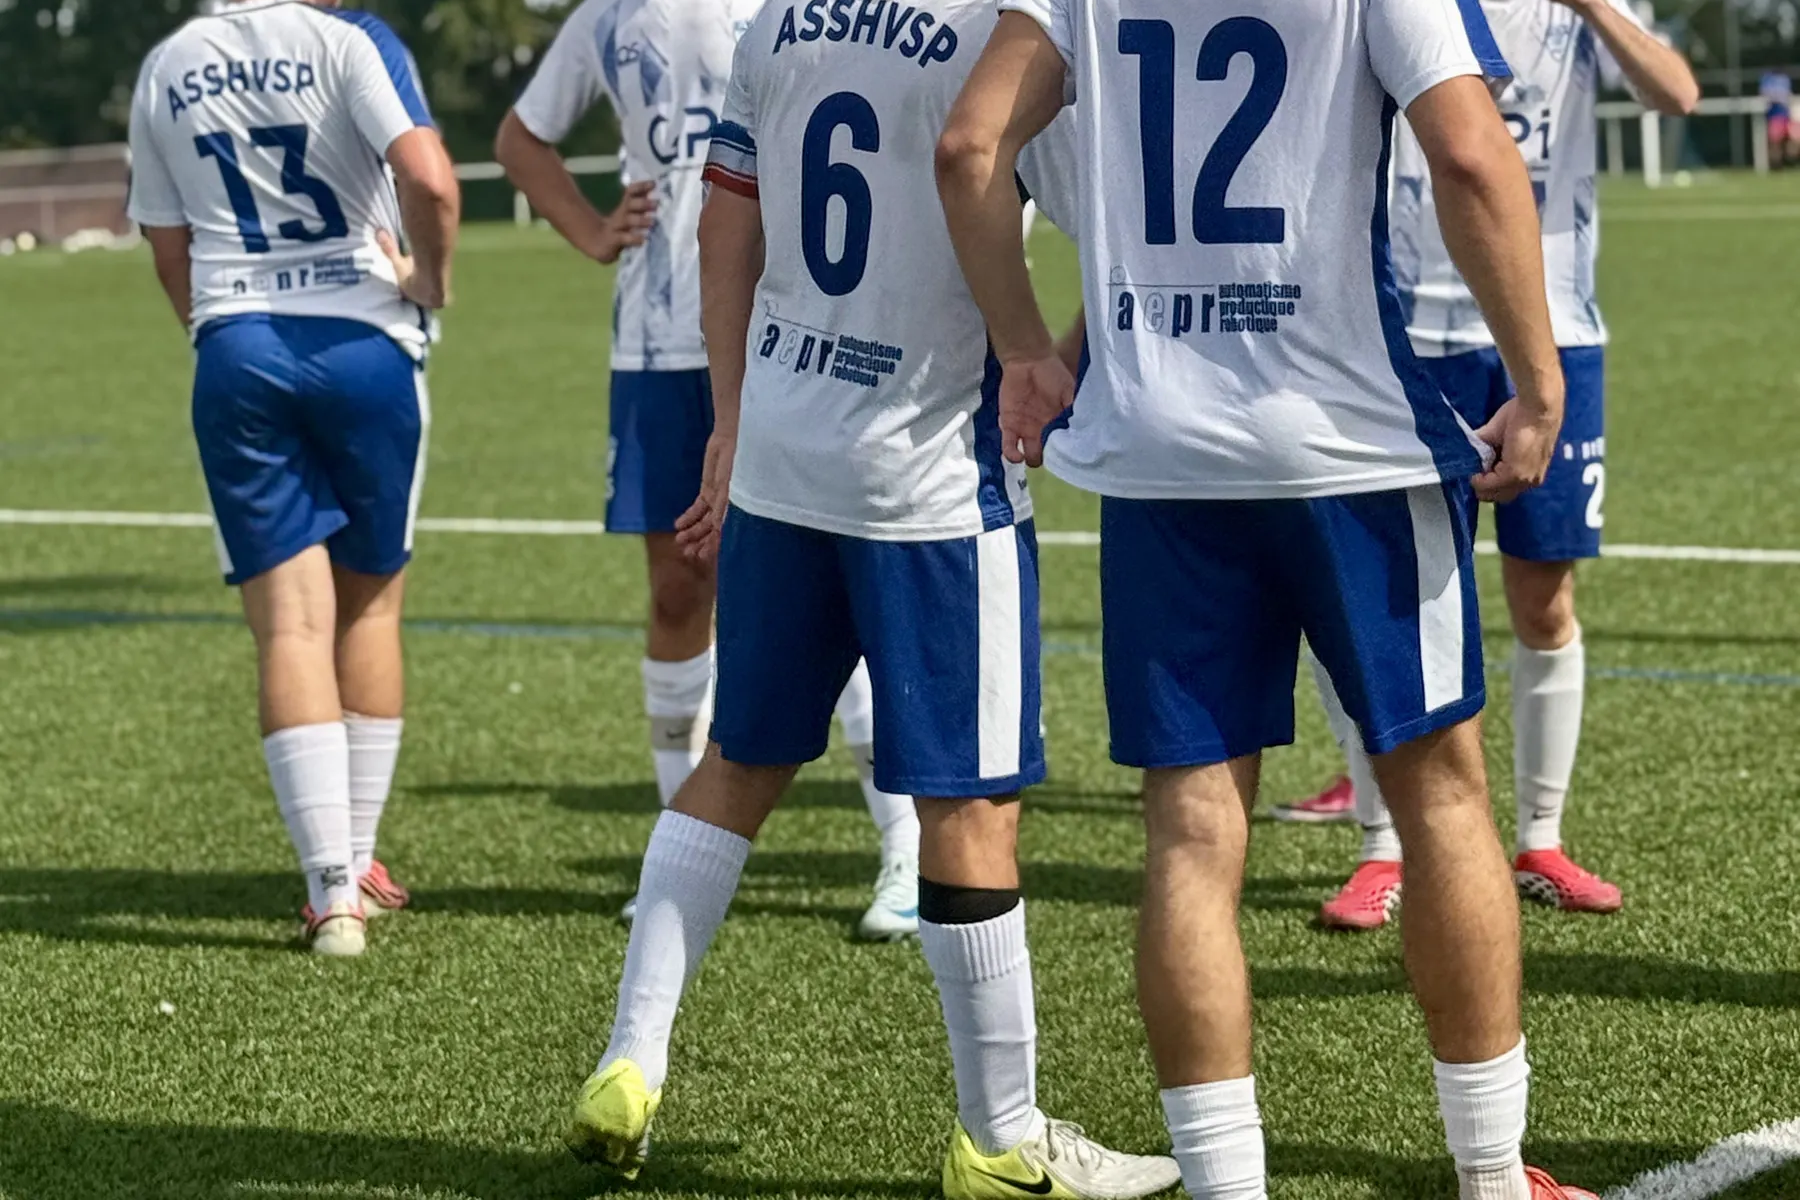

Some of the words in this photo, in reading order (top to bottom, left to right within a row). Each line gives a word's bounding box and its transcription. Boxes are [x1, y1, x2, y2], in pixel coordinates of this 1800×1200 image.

[168, 59, 314, 122] ASSHVSP
[1118, 16, 1288, 245] 12
[194, 124, 350, 254] 13
[801, 91, 880, 296] 6
[1117, 291, 1215, 338] aepr
[1218, 281, 1302, 299] automatisme
[759, 323, 834, 375] aepr
